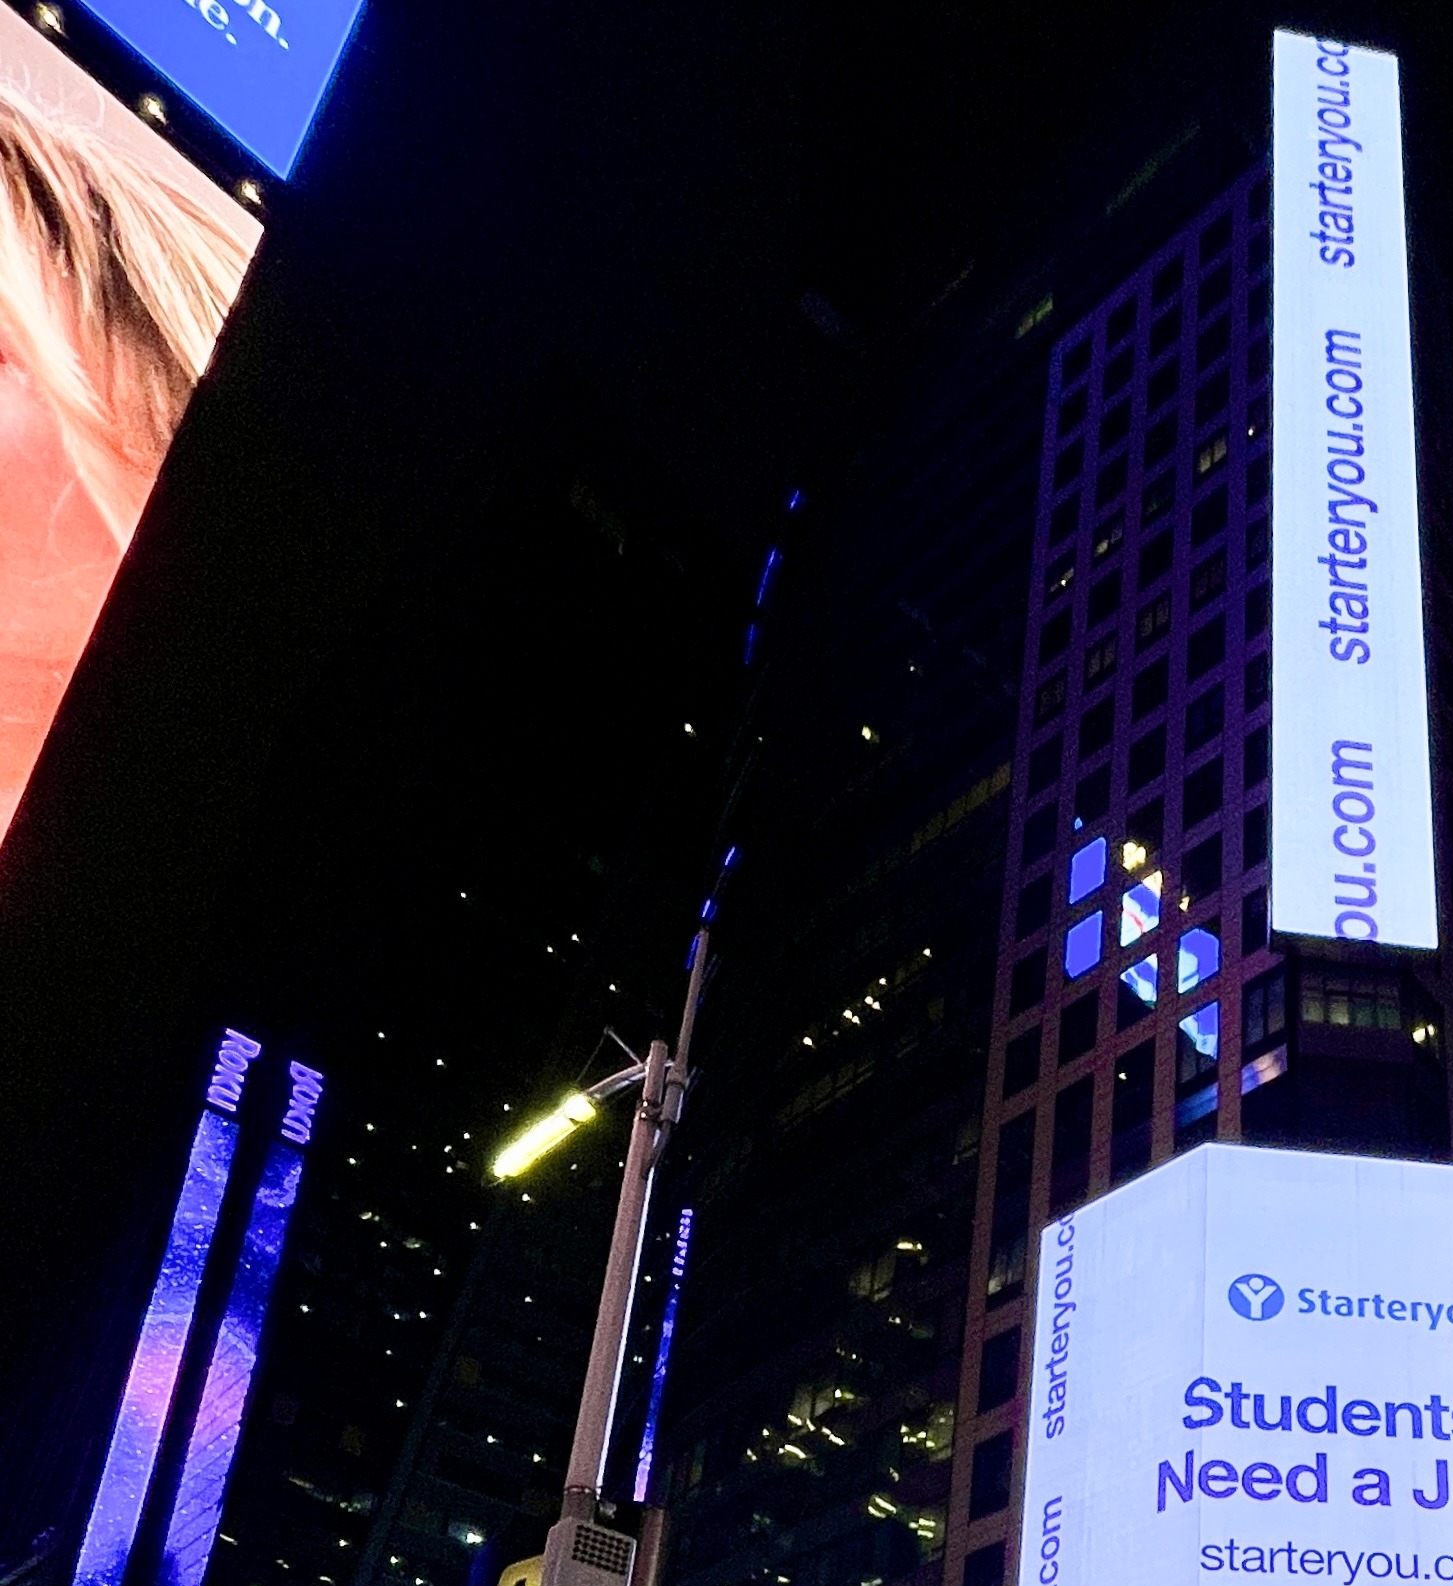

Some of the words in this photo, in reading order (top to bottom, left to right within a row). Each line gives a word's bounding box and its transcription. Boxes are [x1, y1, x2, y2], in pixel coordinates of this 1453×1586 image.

[1317, 328, 1379, 664] starteryou.com
[1156, 1449, 1328, 1515] Need
[1351, 1463, 1392, 1508] a
